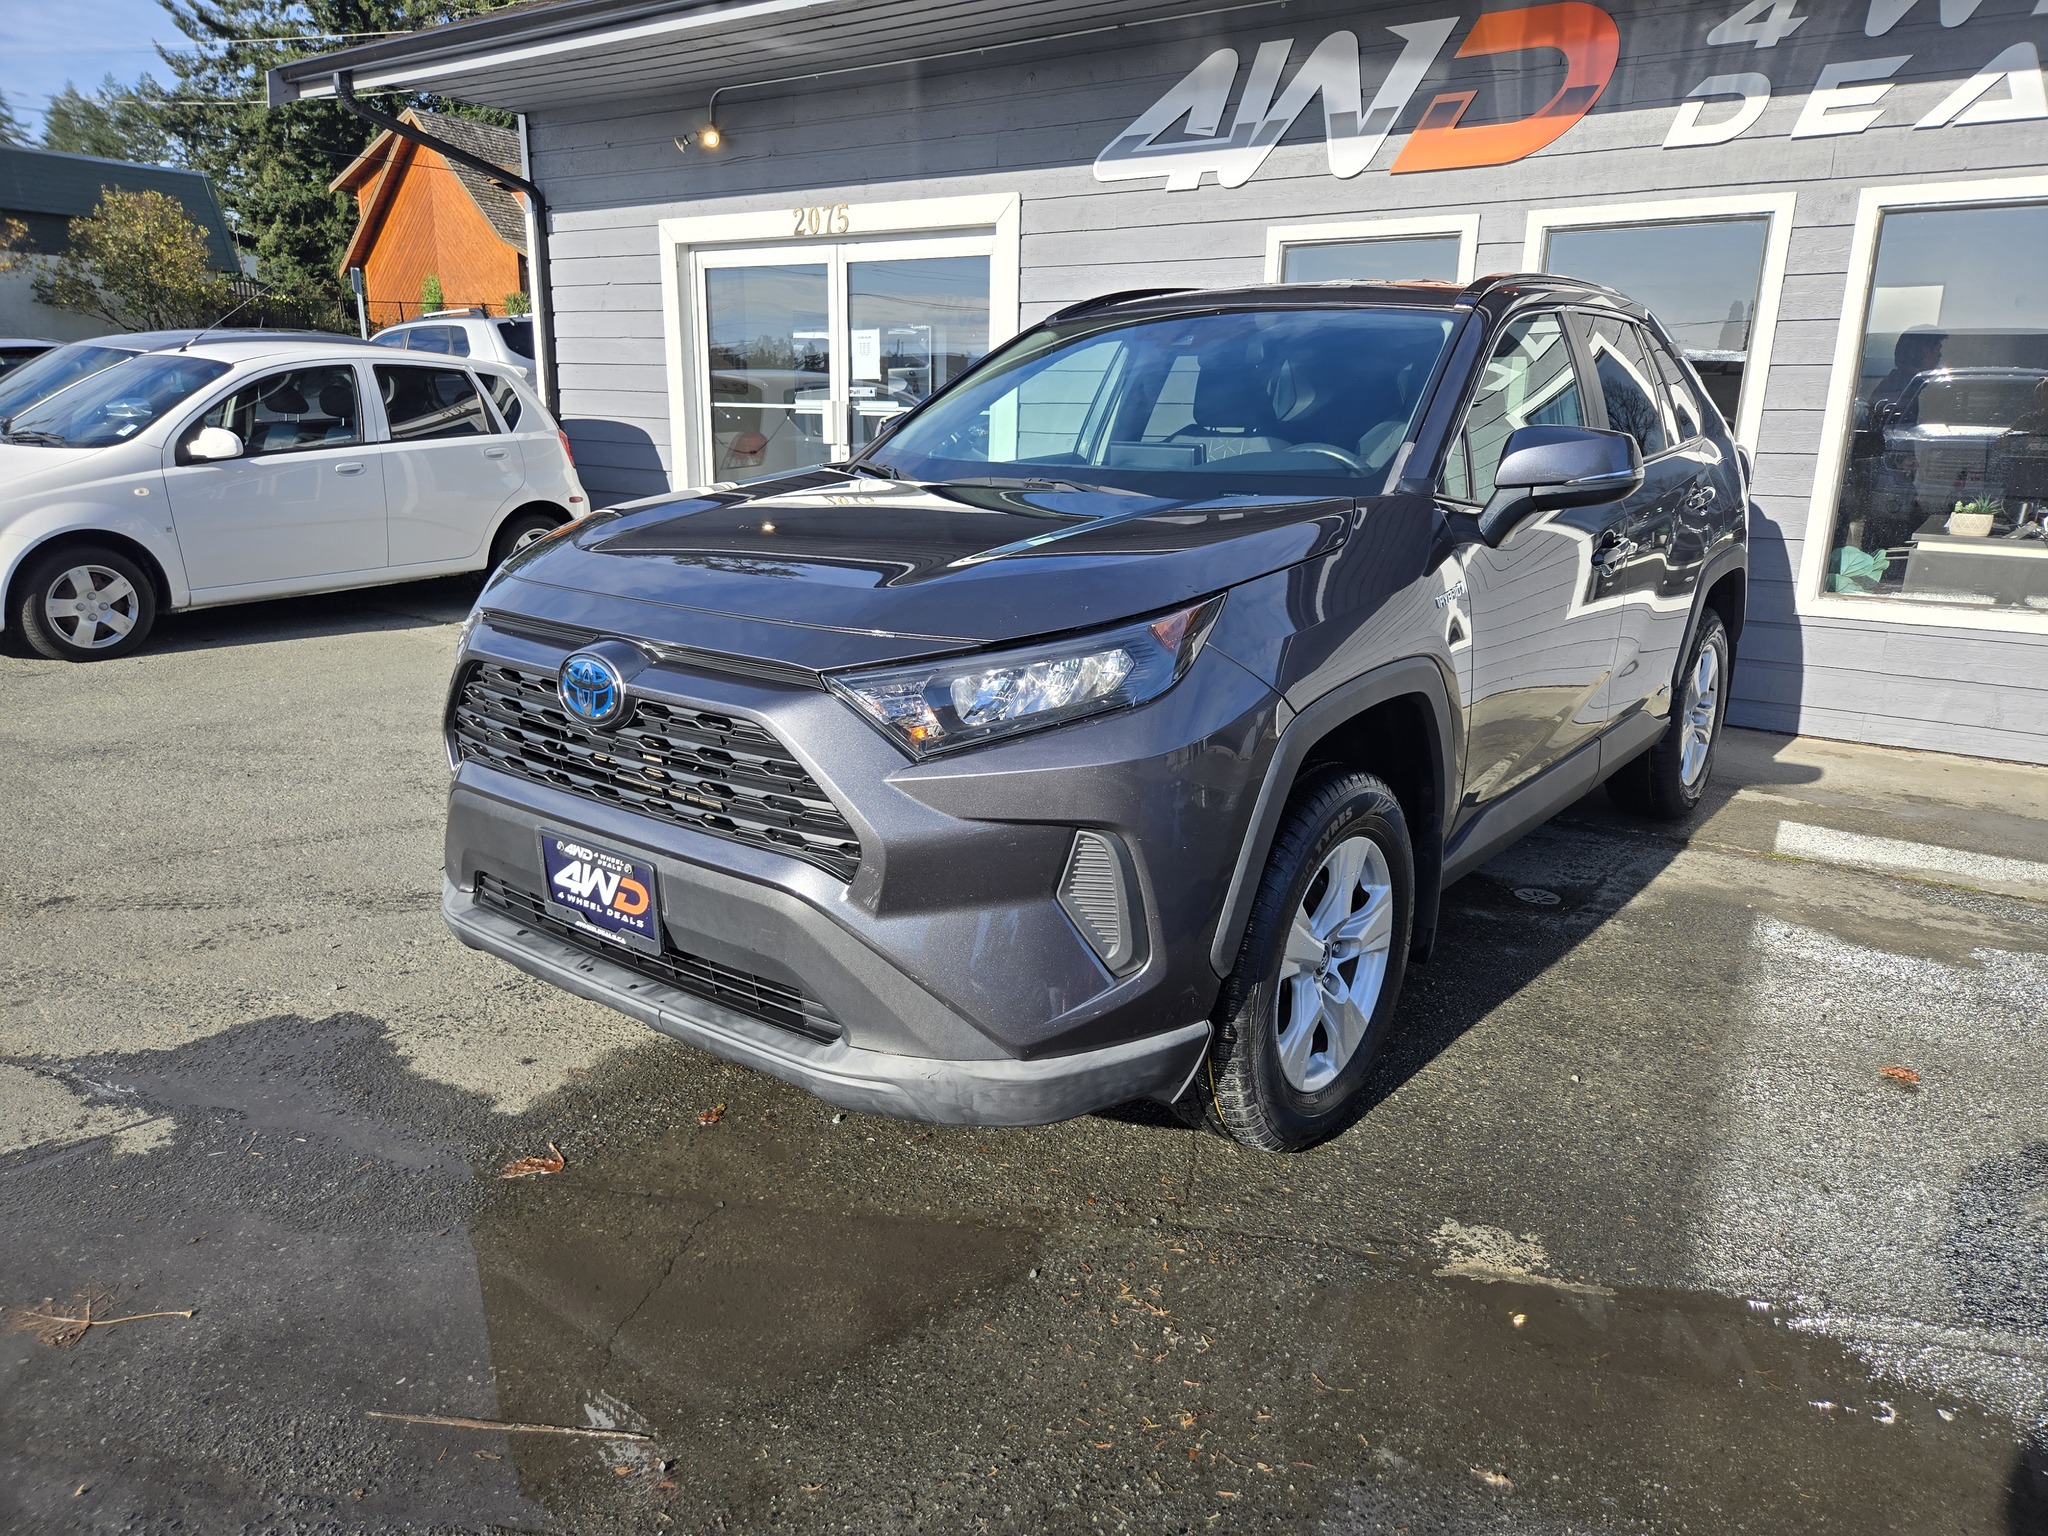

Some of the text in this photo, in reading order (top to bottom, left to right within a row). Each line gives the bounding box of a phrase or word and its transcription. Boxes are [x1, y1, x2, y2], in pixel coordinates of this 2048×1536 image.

[1093, 1, 1620, 192] 4WD
[793, 201, 849, 236] 2075
[1314, 807, 1354, 854] TYRES
[564, 843, 593, 861] 4WD
[600, 854, 624, 866] WHEEL
[597, 859, 622, 872] DEALS
[553, 860, 649, 915] 4WD
[558, 891, 645, 928] 4 WHEEL DEALS
